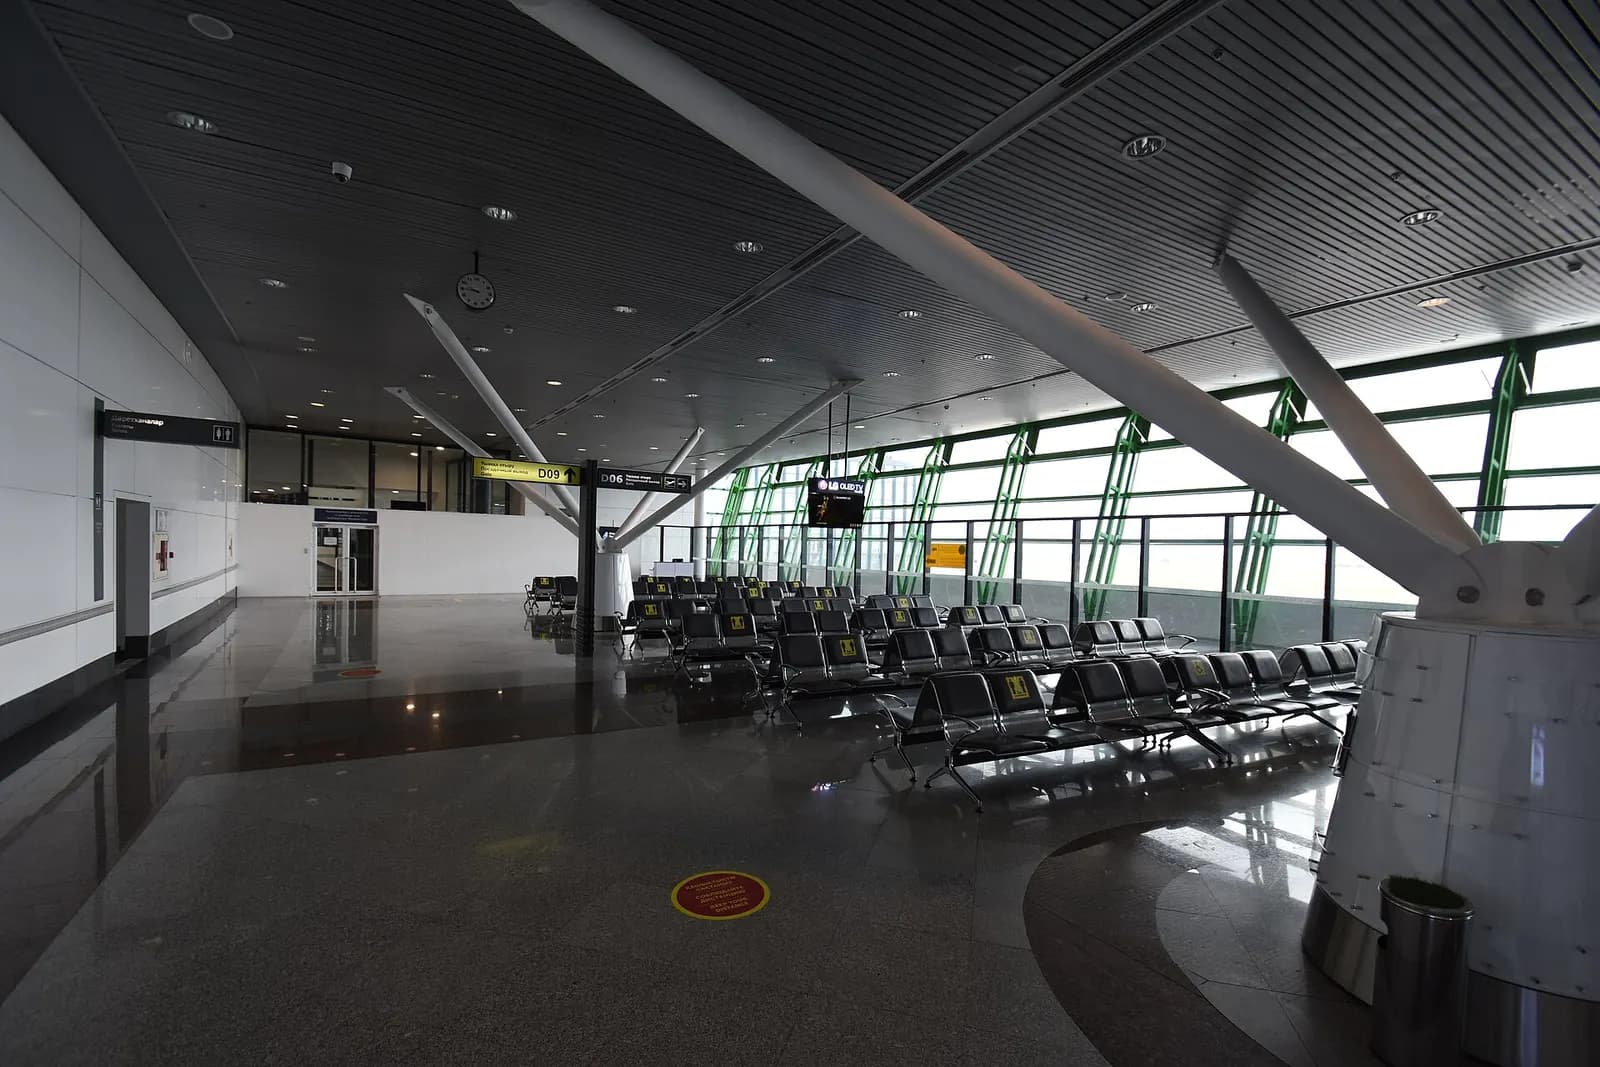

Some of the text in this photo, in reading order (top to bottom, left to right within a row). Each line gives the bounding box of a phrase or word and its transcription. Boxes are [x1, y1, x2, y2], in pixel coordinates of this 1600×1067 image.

[538, 468, 560, 480] D09
[601, 474, 624, 484] D06
[828, 481, 839, 491] LG
